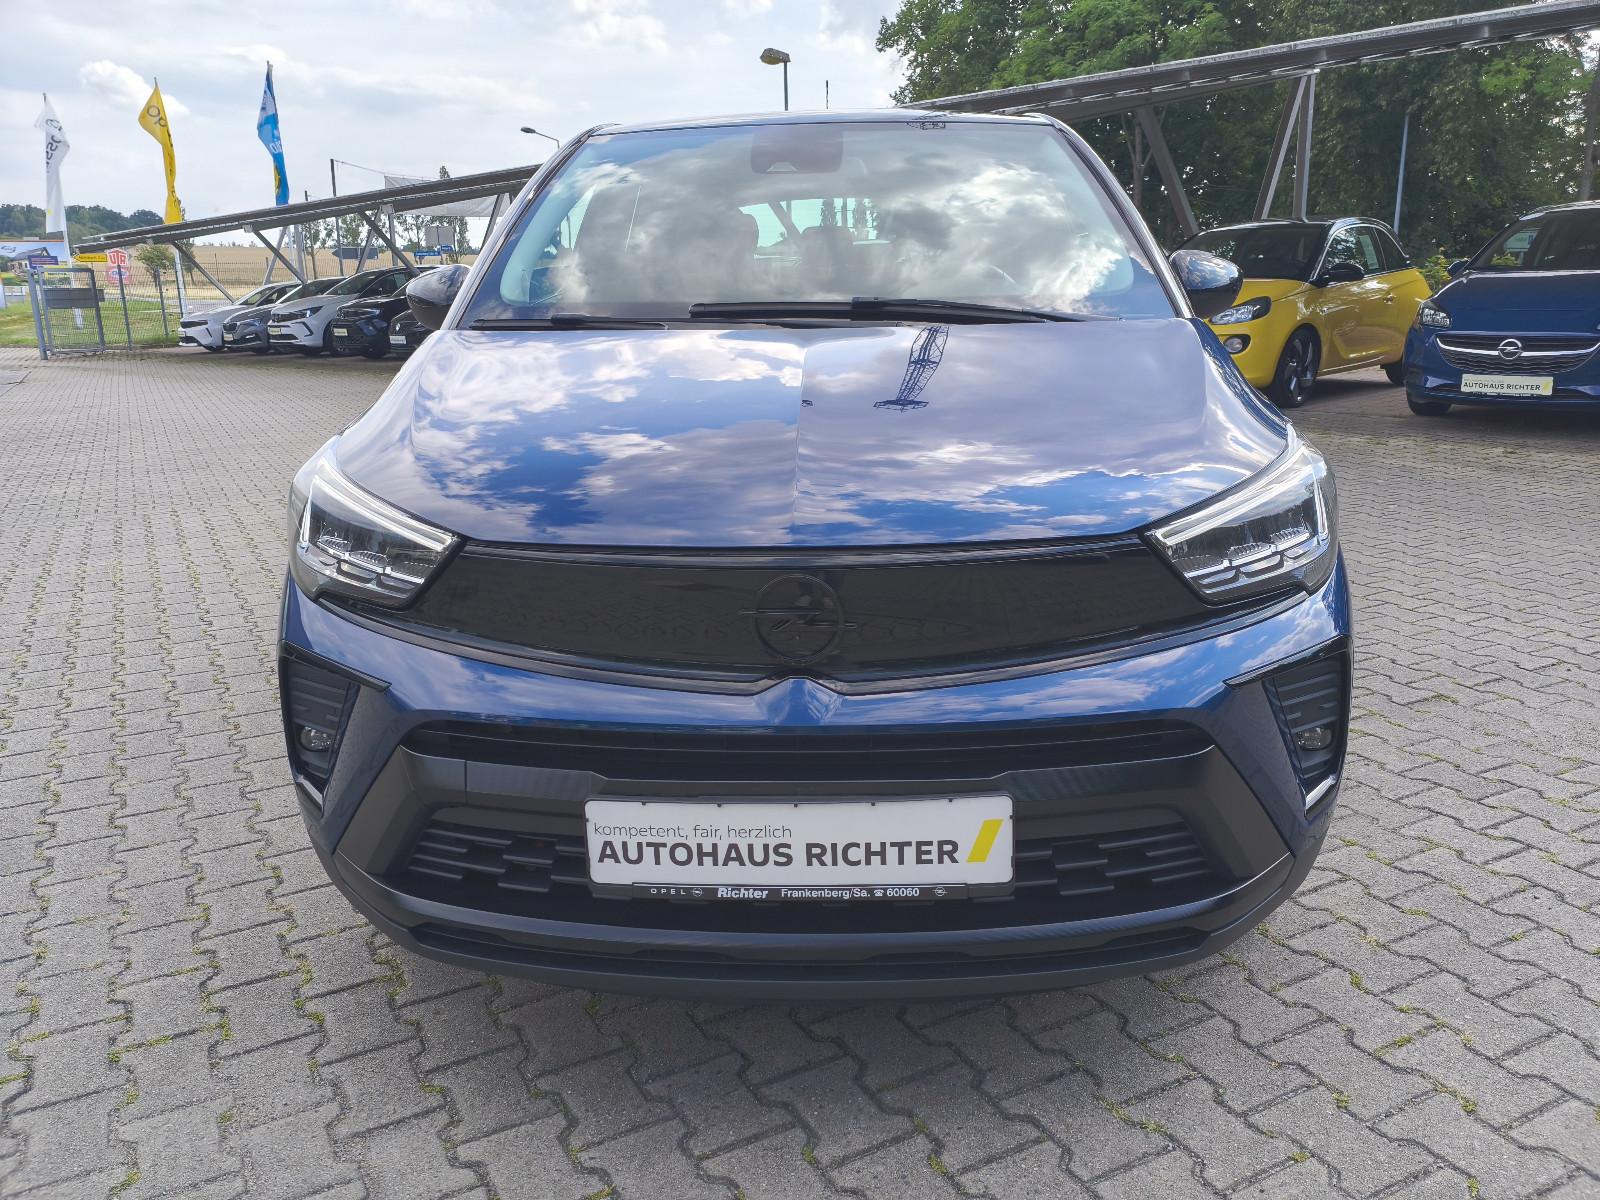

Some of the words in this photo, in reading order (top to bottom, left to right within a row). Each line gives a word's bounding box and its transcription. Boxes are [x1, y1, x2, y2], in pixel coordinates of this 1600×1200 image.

[1463, 382, 1505, 390] AUTOHAUS
[1506, 383, 1541, 391] RICHTER
[594, 822, 689, 840] kompetent,
[692, 824, 722, 840] fair,
[727, 825, 792, 839] herzlich
[597, 840, 794, 867] AUTOHAUS
[805, 839, 960, 867] RICHTER
[717, 887, 769, 899] Richter
[781, 888, 871, 900] Frankenberg/Sa.
[886, 887, 920, 897] 60060
